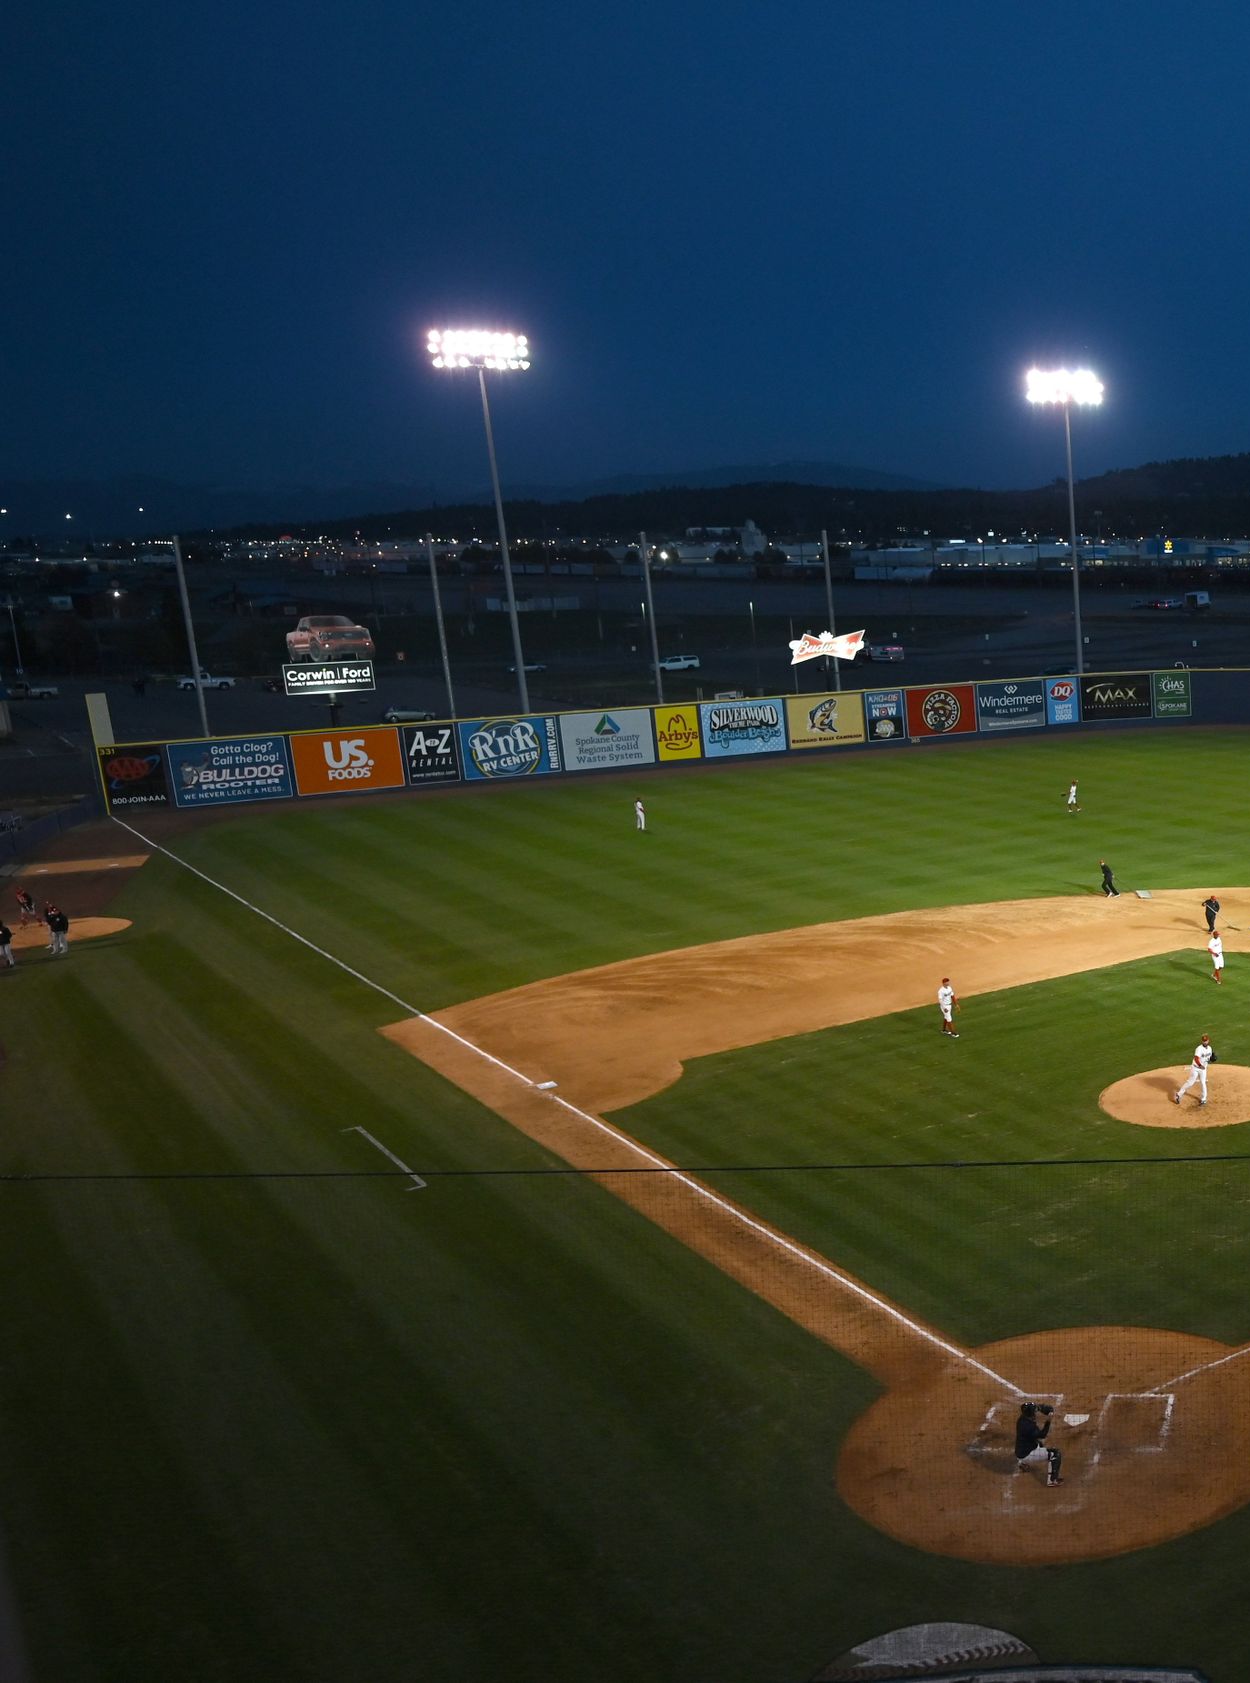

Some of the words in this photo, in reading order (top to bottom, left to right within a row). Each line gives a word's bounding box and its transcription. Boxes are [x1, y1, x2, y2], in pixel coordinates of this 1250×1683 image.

[286, 668, 335, 682] Corwin
[342, 666, 371, 679] Ford
[1053, 685, 1071, 698] DQ
[1162, 679, 1185, 692] CHAS
[979, 693, 1043, 708] Windermere
[1094, 687, 1137, 702] MAX
[872, 707, 897, 717] NOW
[925, 693, 945, 710] PIZZA
[944, 696, 958, 729] FACTORY
[1010, 706, 1029, 714] ESTATE
[711, 705, 778, 730] SILVERWOOD
[729, 721, 746, 729] THEME
[575, 735, 611, 747] Spokane
[610, 733, 640, 745] County
[658, 728, 699, 744] Arby's
[836, 733, 863, 741] CAMPAIGN
[210, 745, 241, 756] Gotta
[242, 741, 273, 754] Clog?
[578, 744, 614, 756] Regional
[615, 741, 639, 751] Solid
[212, 756, 233, 766] Call
[235, 754, 253, 764] the
[255, 752, 280, 764] Dog!
[411, 756, 453, 768] RENTAL
[482, 759, 498, 772] RV
[499, 750, 539, 768] CENTER
[576, 753, 607, 764] Waste
[608, 751, 643, 762] System
[199, 763, 284, 783] BULLDOG
[327, 767, 371, 781] FOODS
[202, 778, 280, 790] ROOTER
[183, 793, 196, 801] WE
[199, 790, 225, 799] NEVER
[227, 788, 251, 797] LEAVE
